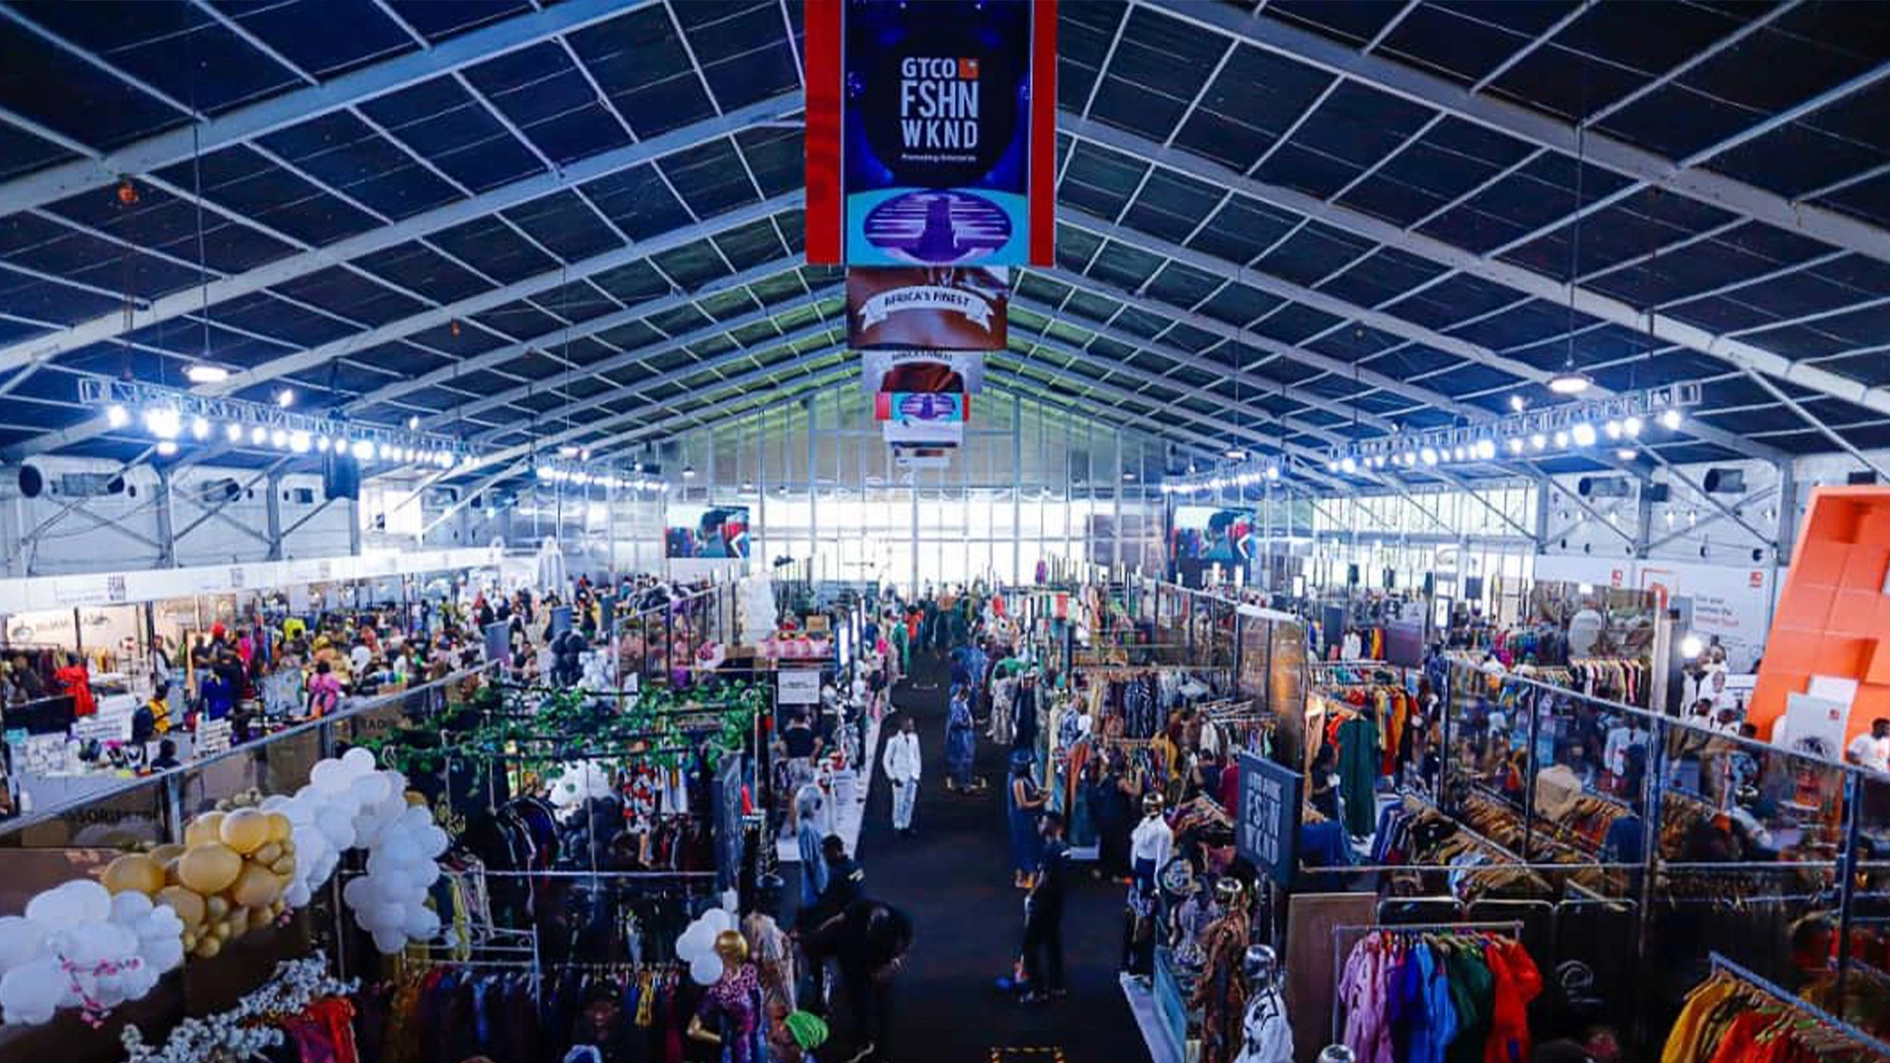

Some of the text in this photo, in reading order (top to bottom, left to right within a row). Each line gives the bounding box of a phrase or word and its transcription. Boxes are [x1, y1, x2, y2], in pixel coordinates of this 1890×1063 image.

[902, 57, 956, 78] GTCO
[901, 80, 978, 118] FSHN
[901, 119, 977, 148] WKND
[884, 290, 970, 307] AFRICA'S FINEST
[1246, 787, 1281, 838] FSHN
